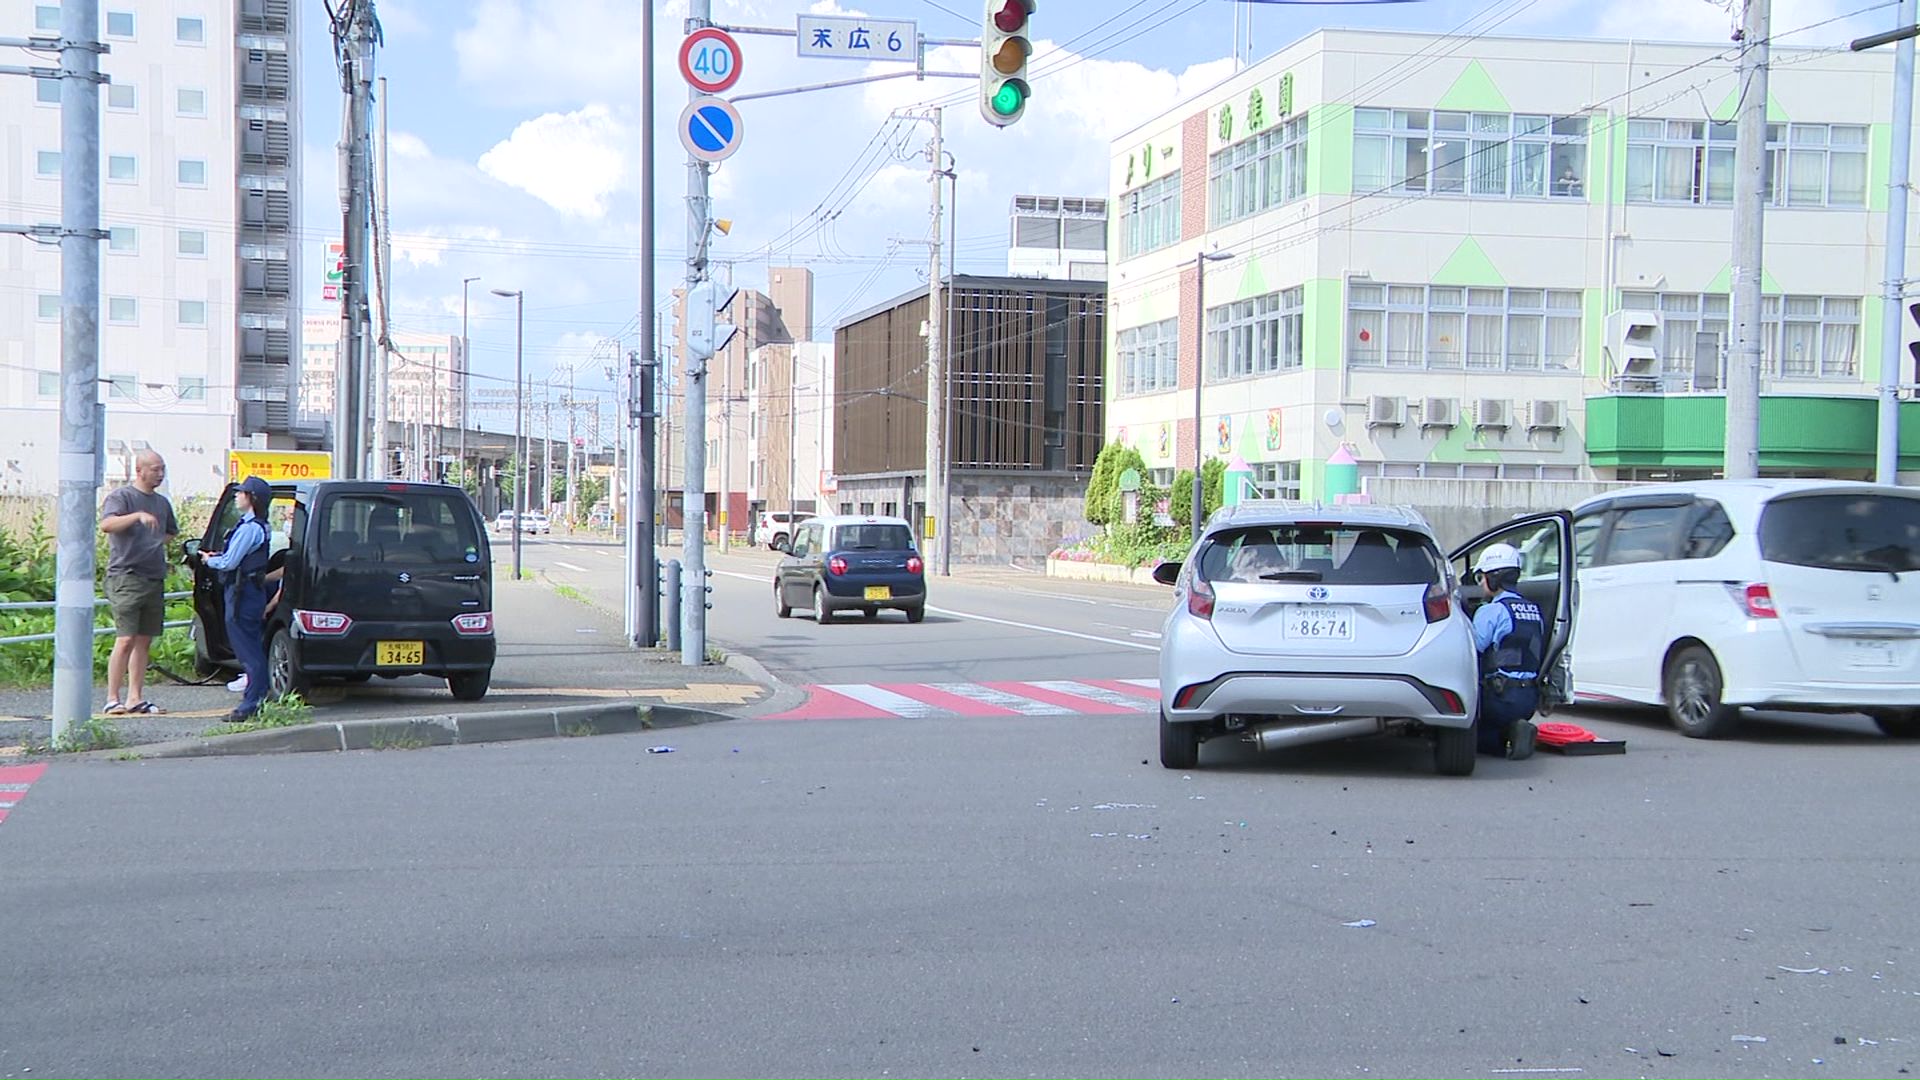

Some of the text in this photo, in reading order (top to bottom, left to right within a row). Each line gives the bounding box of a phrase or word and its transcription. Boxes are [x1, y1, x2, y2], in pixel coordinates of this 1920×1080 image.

[694, 47, 728, 75] 40
[280, 463, 309, 477] 700
[1510, 602, 1539, 614] POLICE
[1300, 620, 1347, 636] 86-74
[387, 651, 421, 664] 34-65
